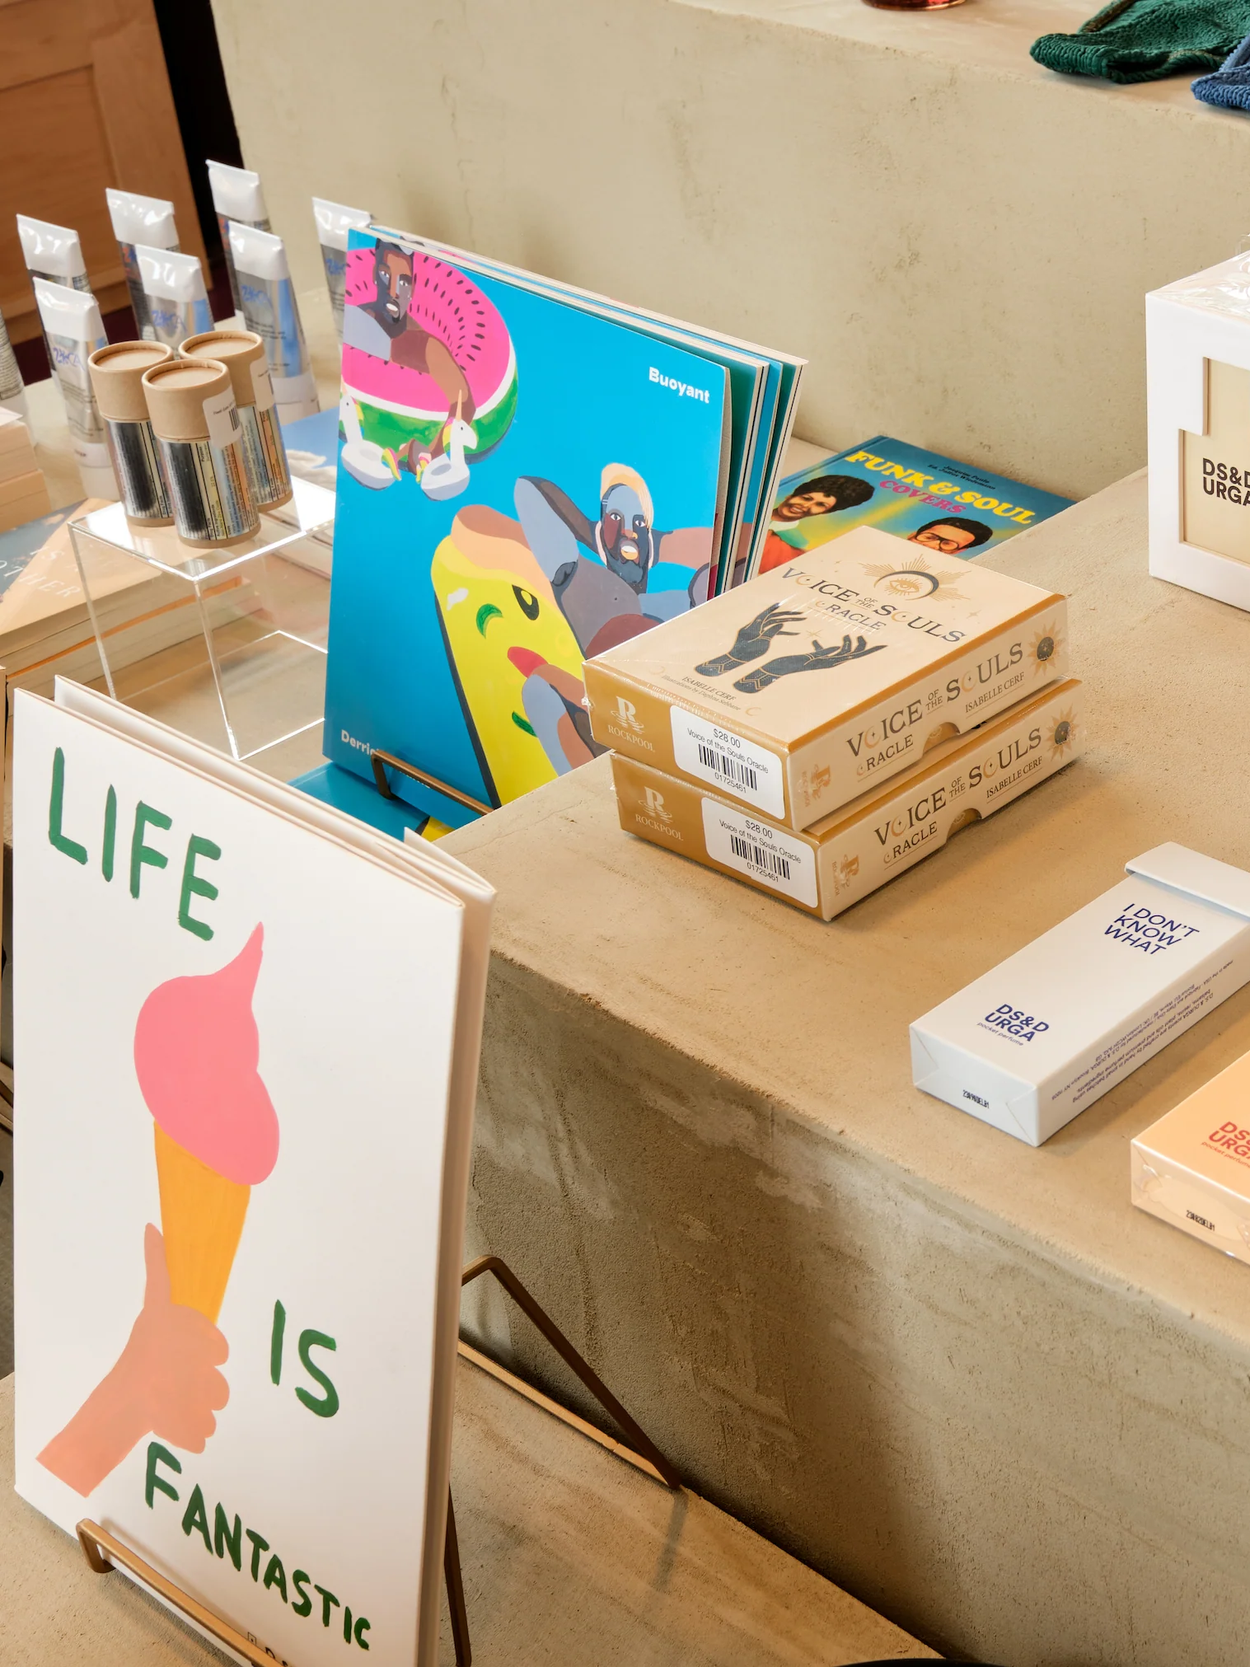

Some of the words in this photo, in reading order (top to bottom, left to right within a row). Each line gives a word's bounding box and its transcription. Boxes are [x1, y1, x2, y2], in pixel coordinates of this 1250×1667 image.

[649, 366, 710, 404] Buoyant
[844, 450, 934, 488] FUNK
[928, 481, 961, 496] &
[954, 488, 1039, 525] SOUL
[879, 480, 967, 514] COVERS
[781, 568, 859, 605] VOICE
[856, 600, 874, 611] THE
[874, 602, 967, 643] SOULS
[946, 642, 1023, 702] SOULS
[682, 676, 714, 693] ISABELLE
[715, 689, 736, 701] CERF
[926, 695, 943, 711] THE
[928, 689, 940, 700] OF
[965, 686, 1002, 714] ISABELLE
[1004, 672, 1025, 694] CERF
[607, 725, 655, 752] ROCKPOOL
[713, 728, 740, 748] $28.00
[846, 699, 922, 758] VOICE
[687, 728, 705, 743] Voice
[707, 737, 713, 745] of
[715, 741, 725, 752] the
[727, 746, 745, 761] Souls
[747, 754, 768, 773] Oracle
[968, 728, 1042, 789] SOULS
[715, 772, 747, 793] 01725461
[949, 782, 966, 798] THE
[951, 776, 963, 788] OF
[986, 768, 1022, 799] ISABELLE
[1023, 756, 1043, 776] CERF
[635, 814, 684, 842] ROCKPOOL
[745, 820, 773, 839] $28.00
[874, 787, 946, 846] VOICE
[48, 746, 222, 941] LIFE
[719, 819, 737, 834] Voice
[739, 829, 746, 837] of
[747, 832, 757, 843] the
[759, 837, 778, 853] Souls
[779, 846, 801, 864] Oracle
[747, 862, 779, 882] 01725461
[1123, 903, 1135, 912] I
[1104, 925, 1166, 955] WHAT
[1114, 915, 1182, 946] KNOW
[985, 1012, 1036, 1042] URGA
[995, 1004, 1049, 1032] DS&D
[977, 1022, 998, 1034] pocket
[998, 1032, 1024, 1046] perfume
[1200, 1141, 1225, 1154] pocket
[270, 1299, 340, 1418] IS
[144, 1441, 372, 1651] FANTASTIC
